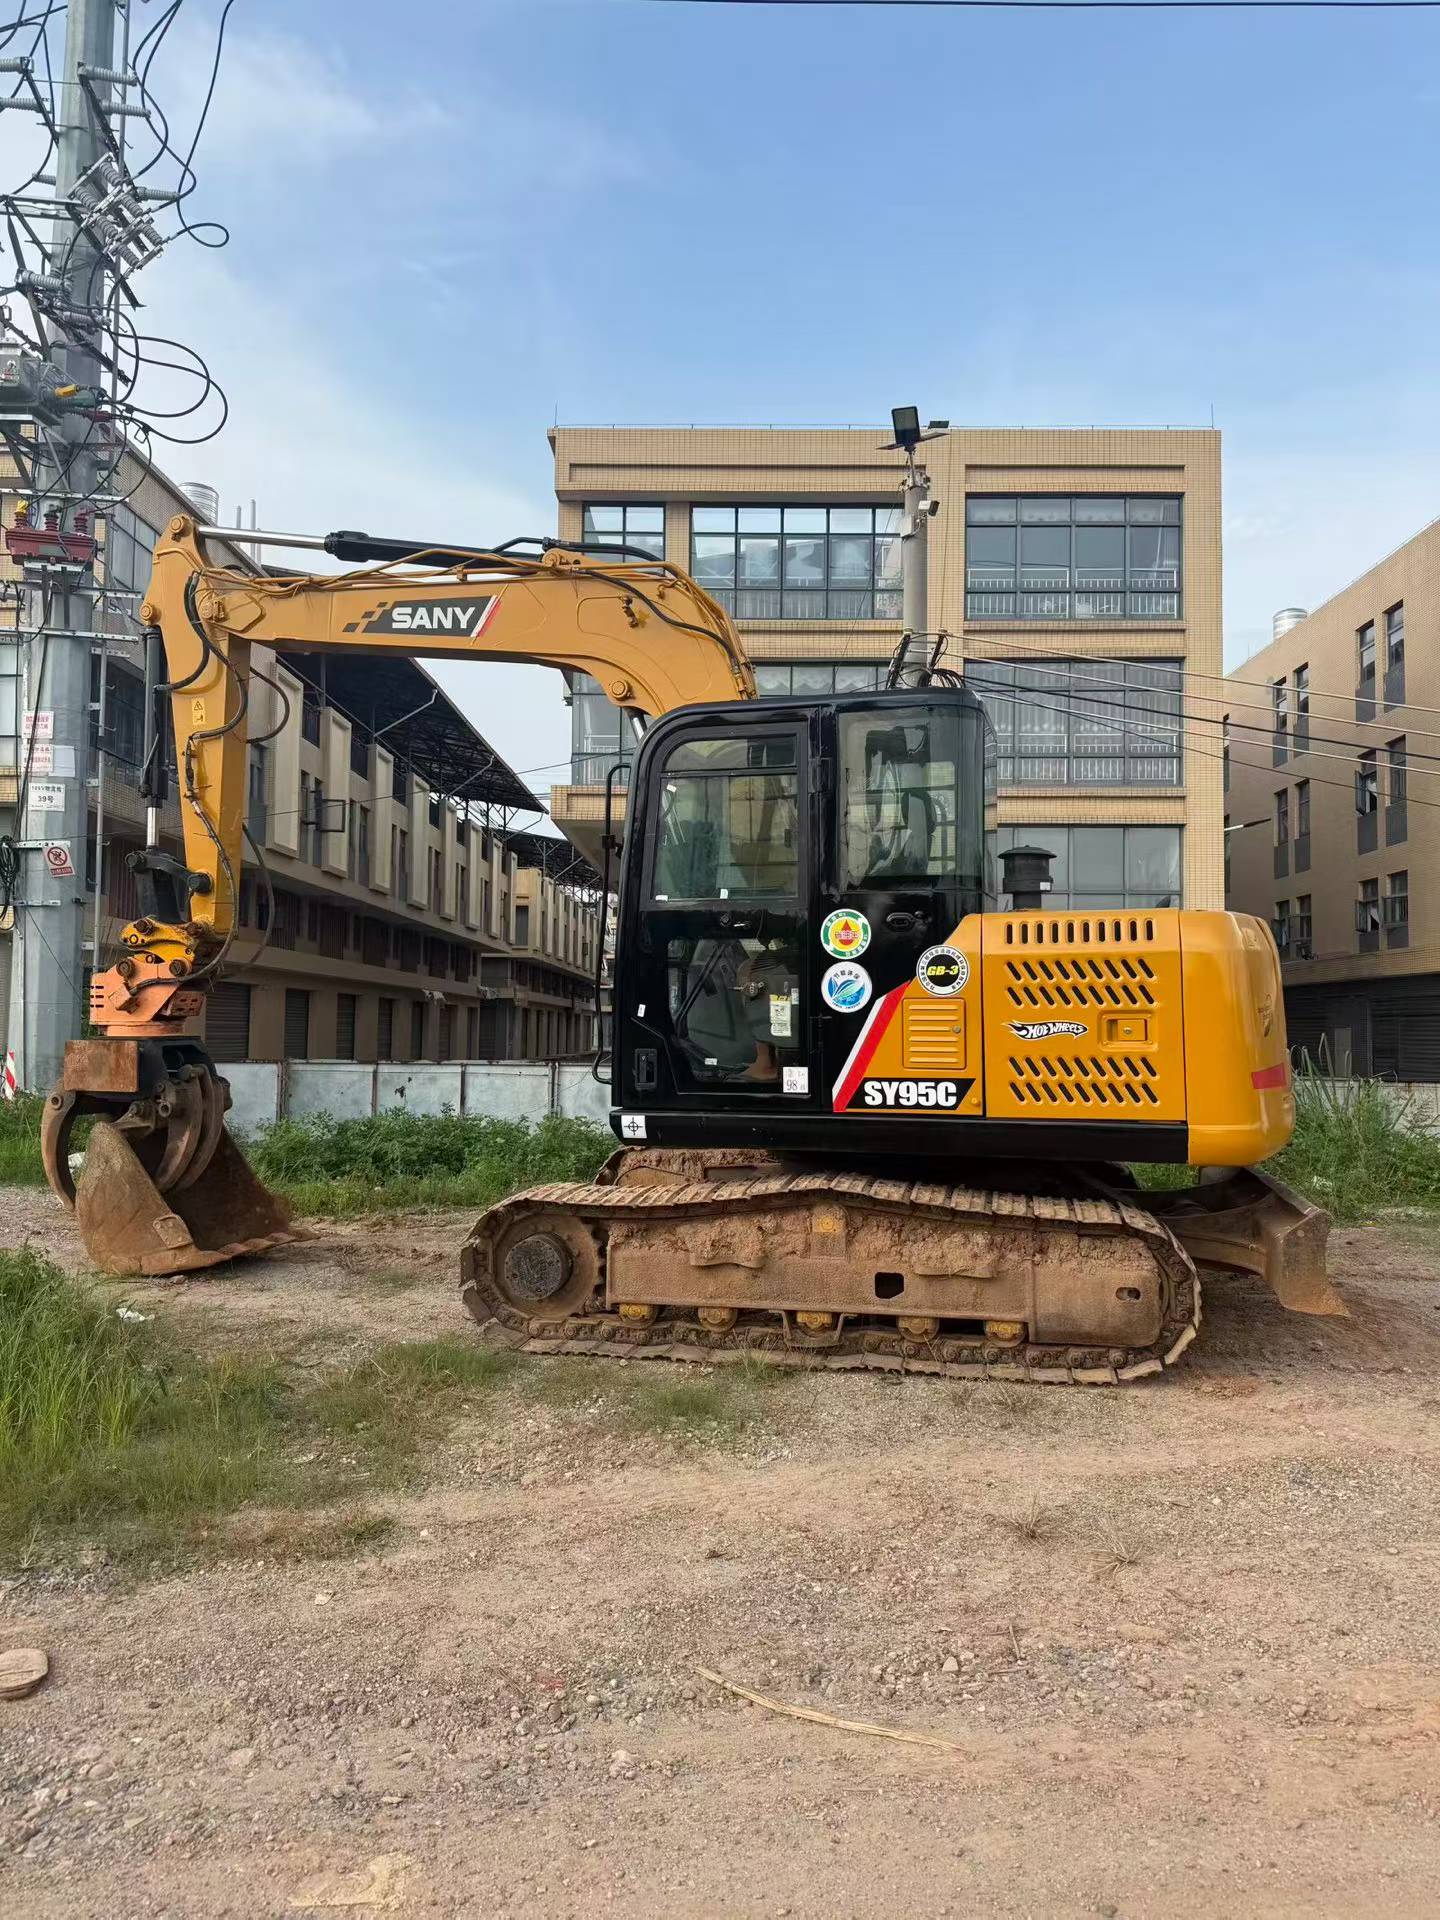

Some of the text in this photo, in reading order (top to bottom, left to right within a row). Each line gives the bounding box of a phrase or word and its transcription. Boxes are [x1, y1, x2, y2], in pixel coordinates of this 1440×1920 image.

[392, 606, 476, 629] SANY
[927, 965, 959, 976] GB-3
[863, 1080, 957, 1107] SY95C
